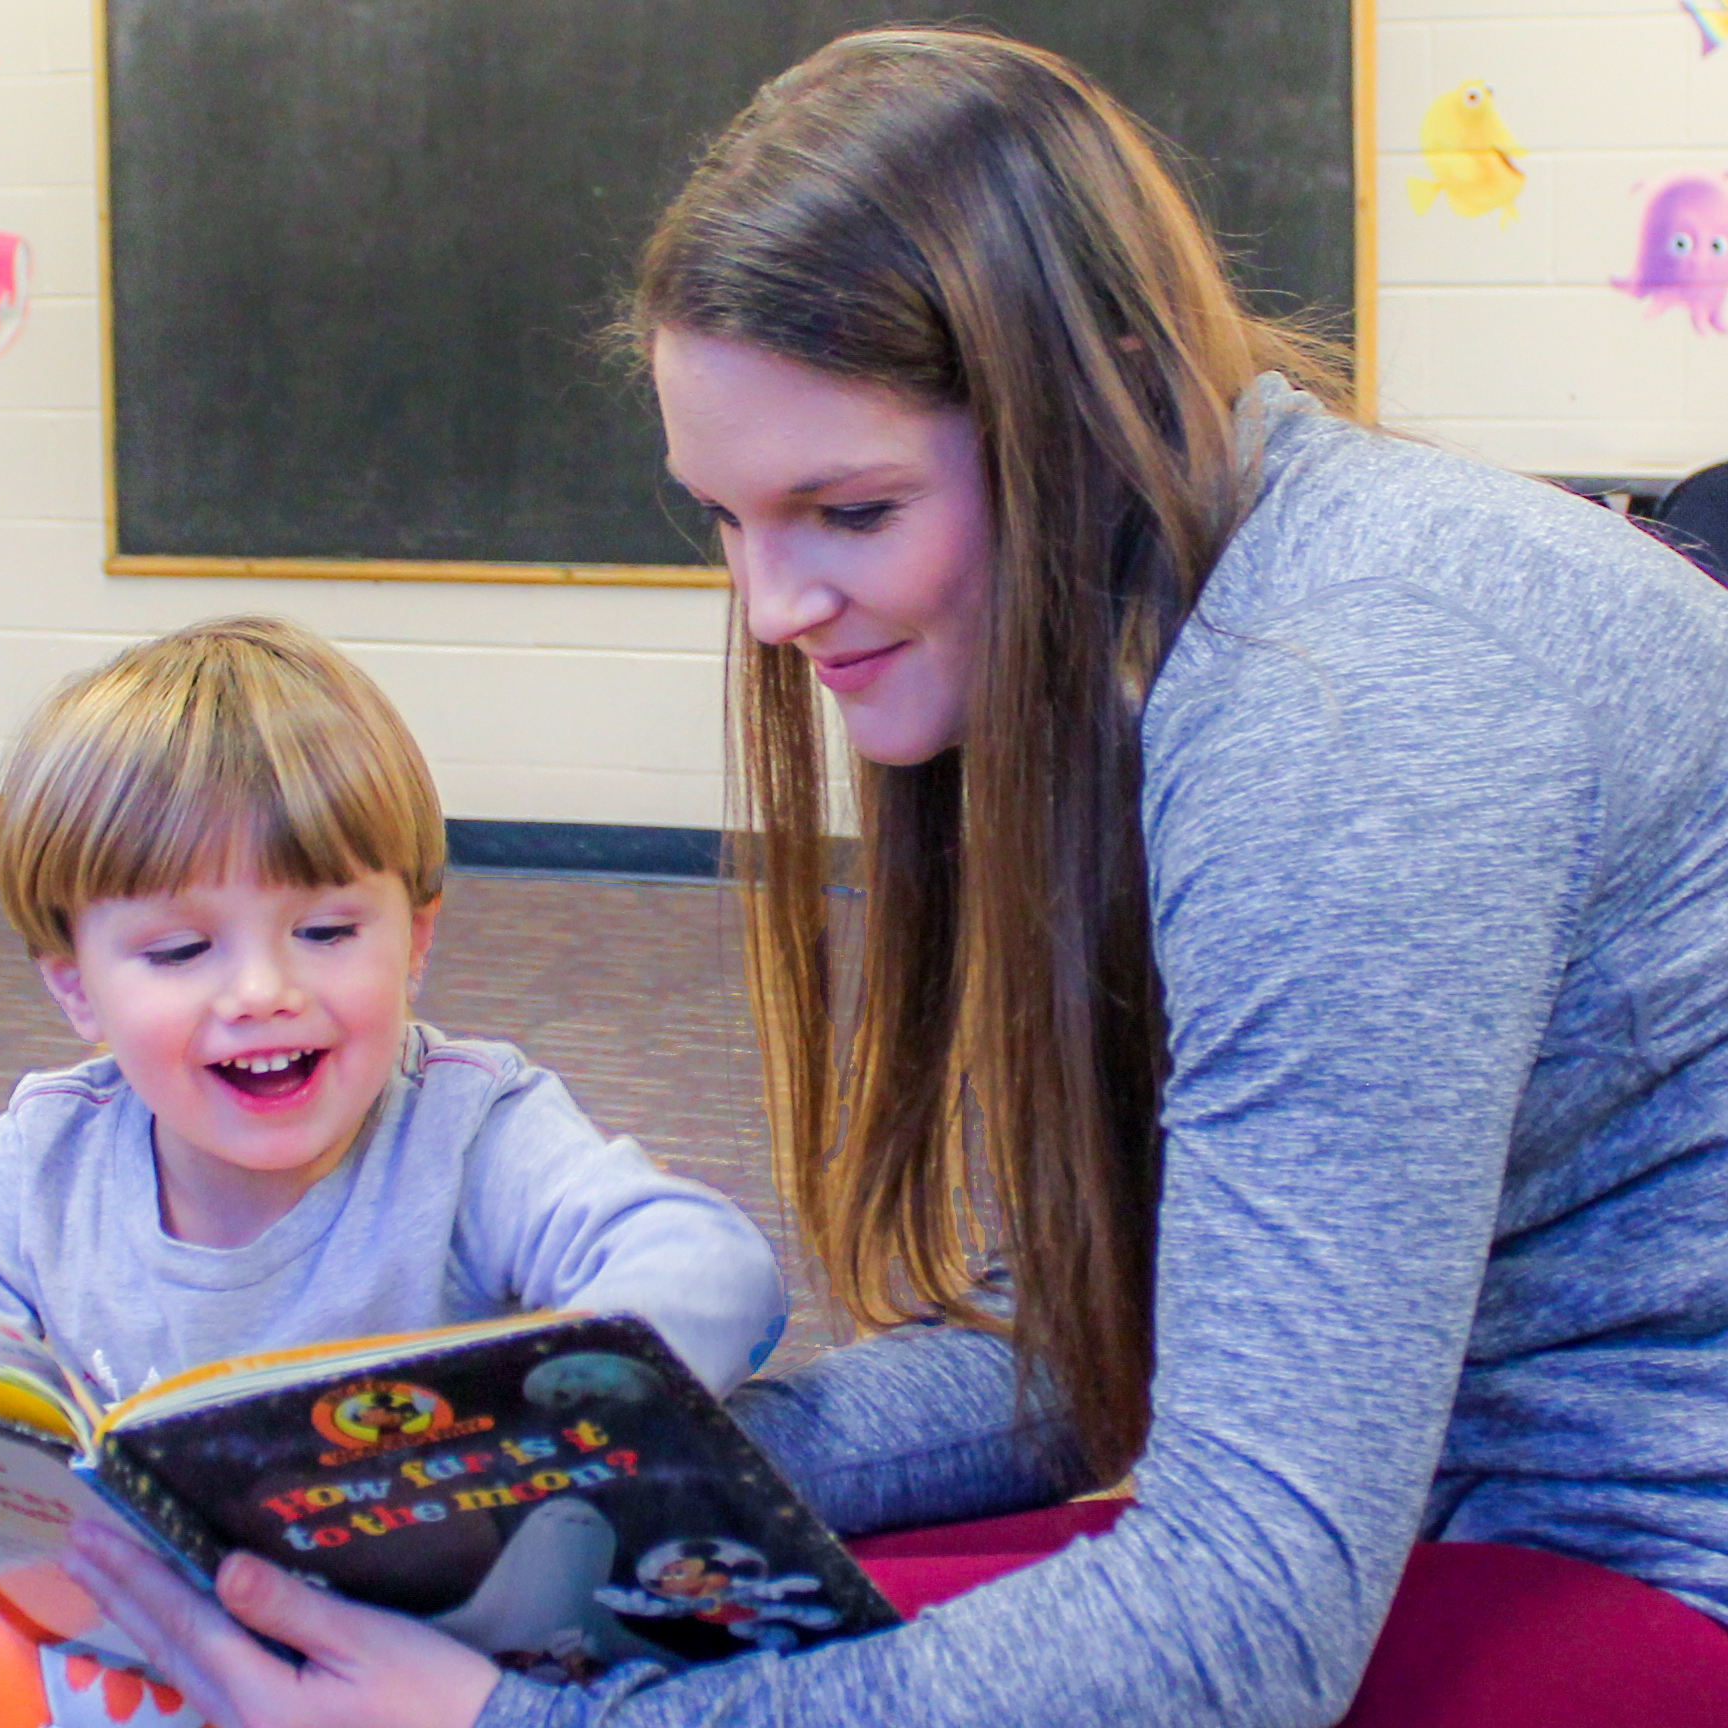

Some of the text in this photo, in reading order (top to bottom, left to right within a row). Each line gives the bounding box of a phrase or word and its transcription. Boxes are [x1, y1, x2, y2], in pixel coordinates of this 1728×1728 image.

[261, 1478, 392, 1523] How
[400, 1451, 493, 1488] far
[499, 1437, 558, 1466] is
[282, 1449, 640, 1551] to the moon?
